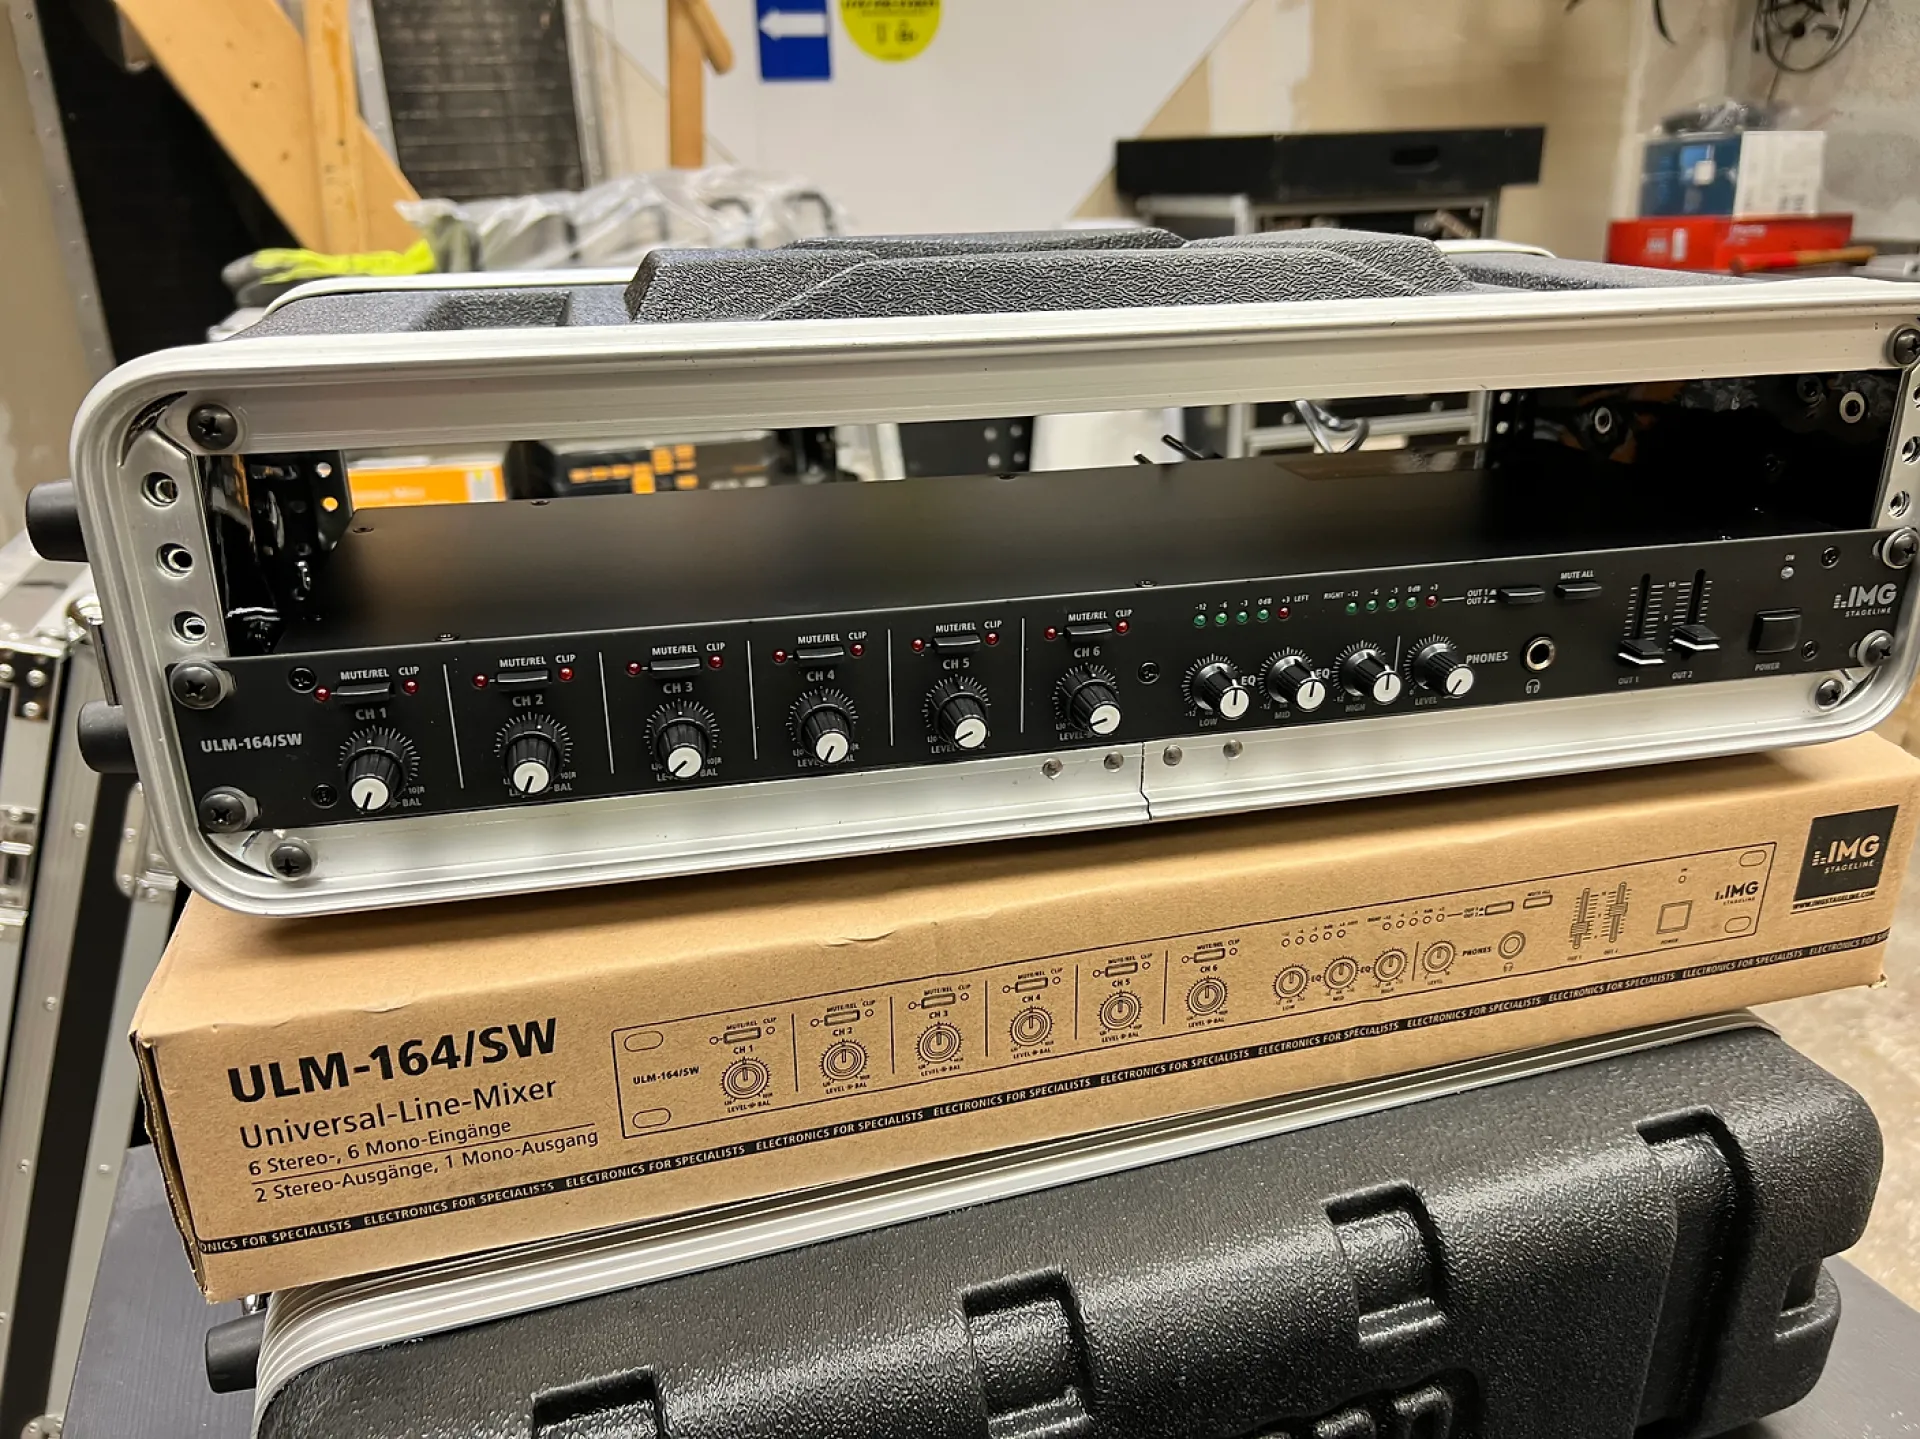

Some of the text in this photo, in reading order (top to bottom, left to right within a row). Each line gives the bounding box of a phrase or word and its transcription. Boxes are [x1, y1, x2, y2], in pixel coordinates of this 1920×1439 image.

[1560, 570, 1594, 580] MUTE ALL
[1323, 591, 1344, 600] RIGHT
[1347, 590, 1359, 598] -12
[1467, 589, 1483, 597] OUT
[1195, 603, 1207, 611] -12
[1294, 594, 1310, 602] LEFT
[1466, 597, 1482, 605] OUT
[1067, 610, 1108, 622] MUTE/REL
[1115, 608, 1134, 619] CLIP
[1845, 606, 1892, 618] STAGELINE
[935, 622, 976, 633] MUTE/REL
[984, 619, 1003, 630] CLIP
[797, 632, 841, 644] MUTE/REL
[848, 630, 867, 641] CLIP
[651, 644, 699, 656] MUTE/REL
[706, 641, 726, 652] CLIP
[1073, 646, 1101, 659] CH 6
[1466, 651, 1509, 665] PHONES
[499, 655, 547, 668] MUTE/REL
[555, 653, 577, 664] CLIP
[942, 658, 970, 670] CH 5
[398, 666, 420, 676] CLIP
[1754, 662, 1781, 672] POWER
[340, 668, 390, 681] MUTE/REL
[806, 669, 836, 682] CH 4
[1316, 668, 1330, 679] EQ
[1672, 671, 1685, 680] OUT
[1241, 675, 1256, 687] EQ
[663, 681, 694, 695] CH 3
[512, 694, 544, 707] CH 2
[1415, 696, 1438, 706] LEVEL
[1345, 703, 1366, 713] HIGH
[355, 707, 387, 721] CH 1
[1274, 710, 1291, 720] MID
[1200, 718, 1218, 727] LOW
[200, 733, 303, 753] ULM-164/SW
[701, 767, 719, 778] BAL
[553, 782, 573, 792] BAL
[402, 798, 422, 808] BAL
[1824, 859, 1875, 874] STAGELINE
[832, 1028, 846, 1037] CH
[733, 1046, 746, 1055] CH
[227, 1017, 558, 1104] ULM-164/SW
[632, 1065, 700, 1086] ULM-164/SW
[242, 1235, 268, 1248] FOR
[272, 1220, 352, 1244] SPECIALISTS
[363, 1201, 449, 1226] ELECTRONICS
[452, 1195, 477, 1209] FOR
[479, 1181, 555, 1204] SPECIALISTS
[565, 1164, 645, 1189] ELECTRONICS
[648, 1158, 671, 1171] FOR
[675, 1144, 745, 1167] SPECIALISTS
[756, 1128, 830, 1151] ELECTRONICS
[833, 1123, 855, 1137] FOR
[857, 1109, 924, 1133] SPECIALISTS
[933, 1094, 1003, 1117] ELECTRONICS
[1006, 1090, 1026, 1102] FOR
[1029, 1077, 1091, 1099] SPECIALISTS
[1100, 1063, 1167, 1085] ELECTRONICS
[1168, 1060, 1188, 1072] FOR
[1191, 1049, 1250, 1069] SPECIALISTS
[1257, 1036, 1322, 1056] ELECTRONICS
[1323, 1032, 1341, 1043] FOR
[1343, 1022, 1399, 1039] SPECIALISTS
[1407, 1010, 1467, 1028] ELECTRONICS
[1468, 1005, 1486, 1017] FOR
[1489, 996, 1542, 1014] SPECIALISTS
[1548, 984, 1604, 1002] ELECTRONICS
[1606, 981, 1623, 992] FOR
[1624, 972, 1676, 988] SPECIALISTS
[1681, 961, 1736, 978] ELECTRONICS
[1737, 958, 1753, 968] FOR
[1755, 949, 1803, 965] SPECIALISTS
[1809, 938, 1861, 955] ELECTRONICS
[239, 1077, 557, 1150] Universal-Line-Mixer
[248, 1119, 511, 1177] 6 Stereo-, 6 Mono-Eingänge
[254, 1129, 599, 1203] 2 Stereo-Ausgänge, 1 Mono-Ausgang
